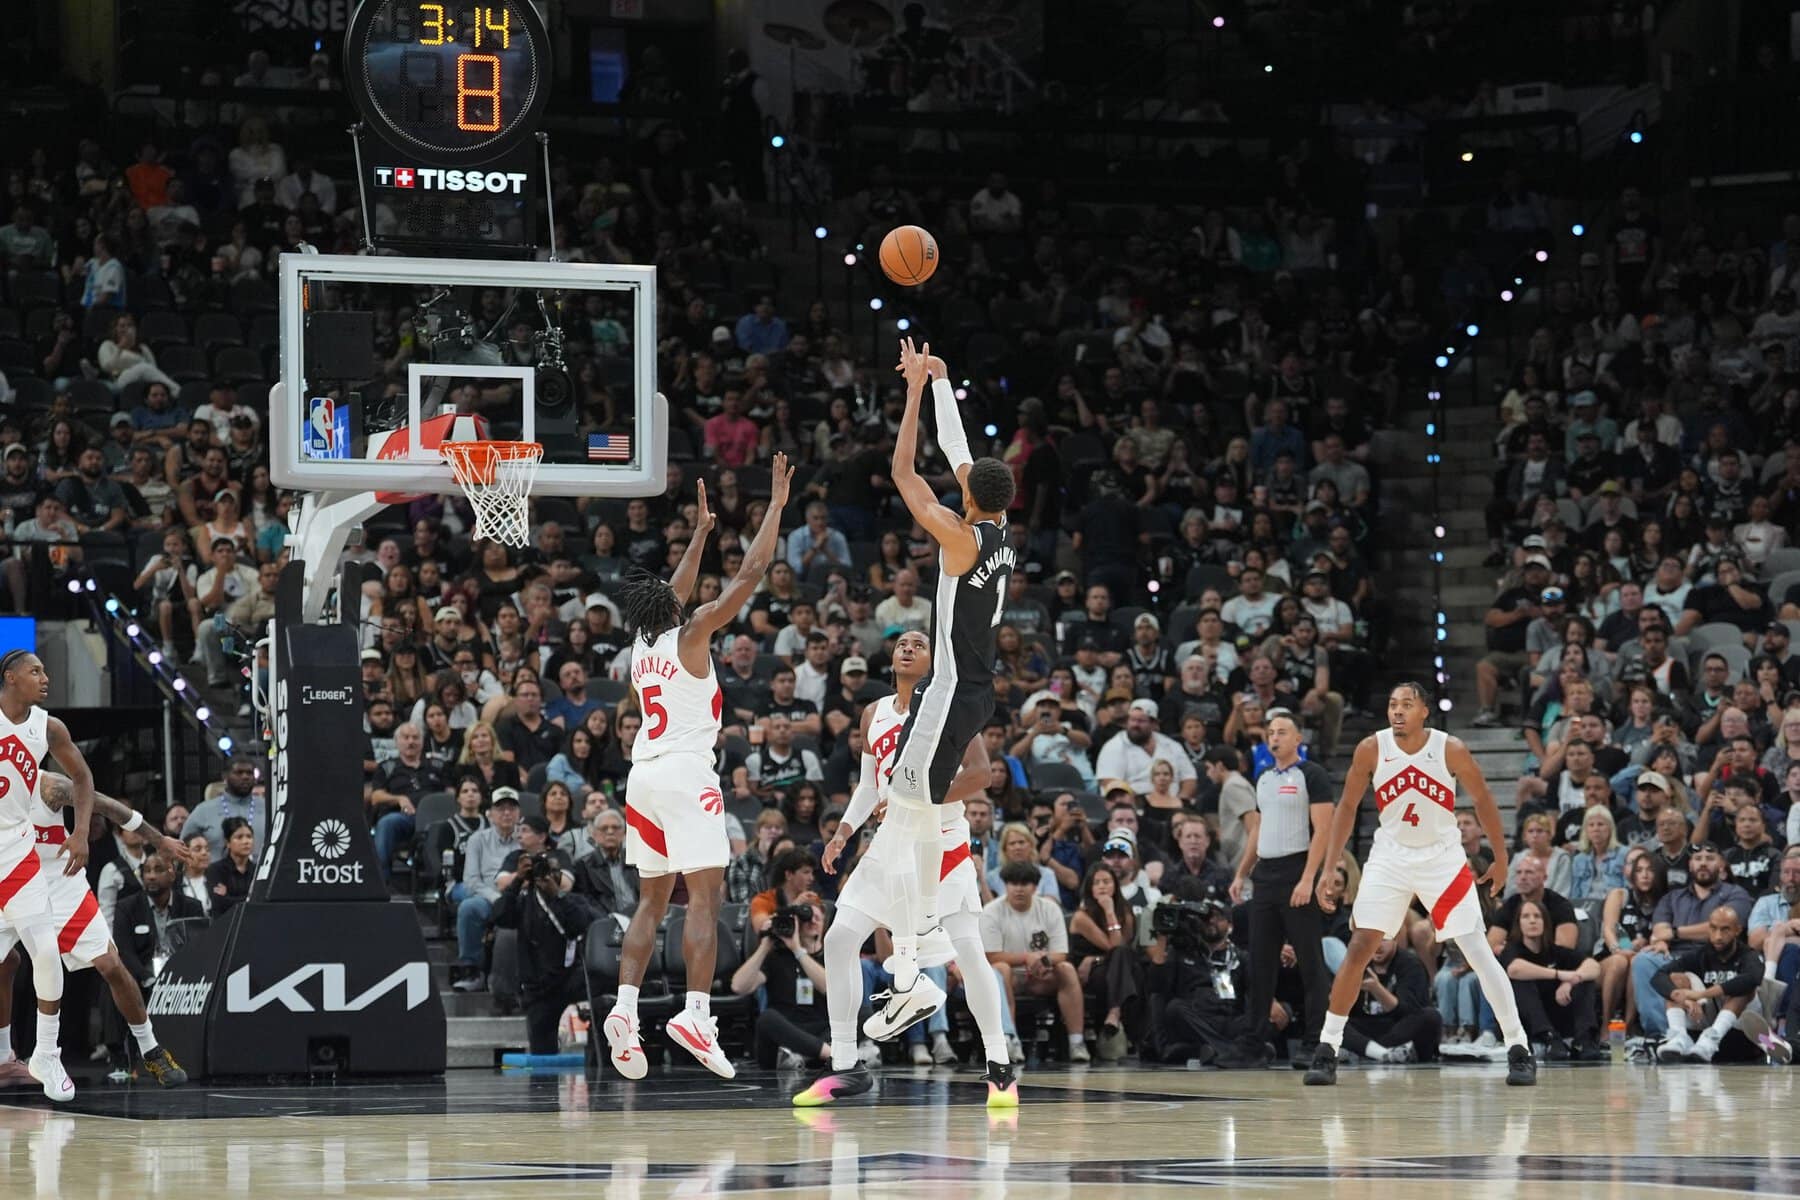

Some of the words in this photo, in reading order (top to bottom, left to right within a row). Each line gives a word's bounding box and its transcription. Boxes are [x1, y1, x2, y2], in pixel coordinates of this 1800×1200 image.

[420, 4, 509, 49] 3:14
[457, 54, 500, 132] 8
[417, 168, 527, 194] TISSOT
[990, 574, 1006, 628] 1
[309, 690, 346, 701] LEDGER
[642, 684, 668, 740] 5
[256, 679, 288, 880] bet365
[1380, 772, 1446, 803] RAPTORS
[1402, 803, 1420, 827] 4
[297, 858, 364, 884] Frost
[146, 971, 213, 1015] ticketmaster
